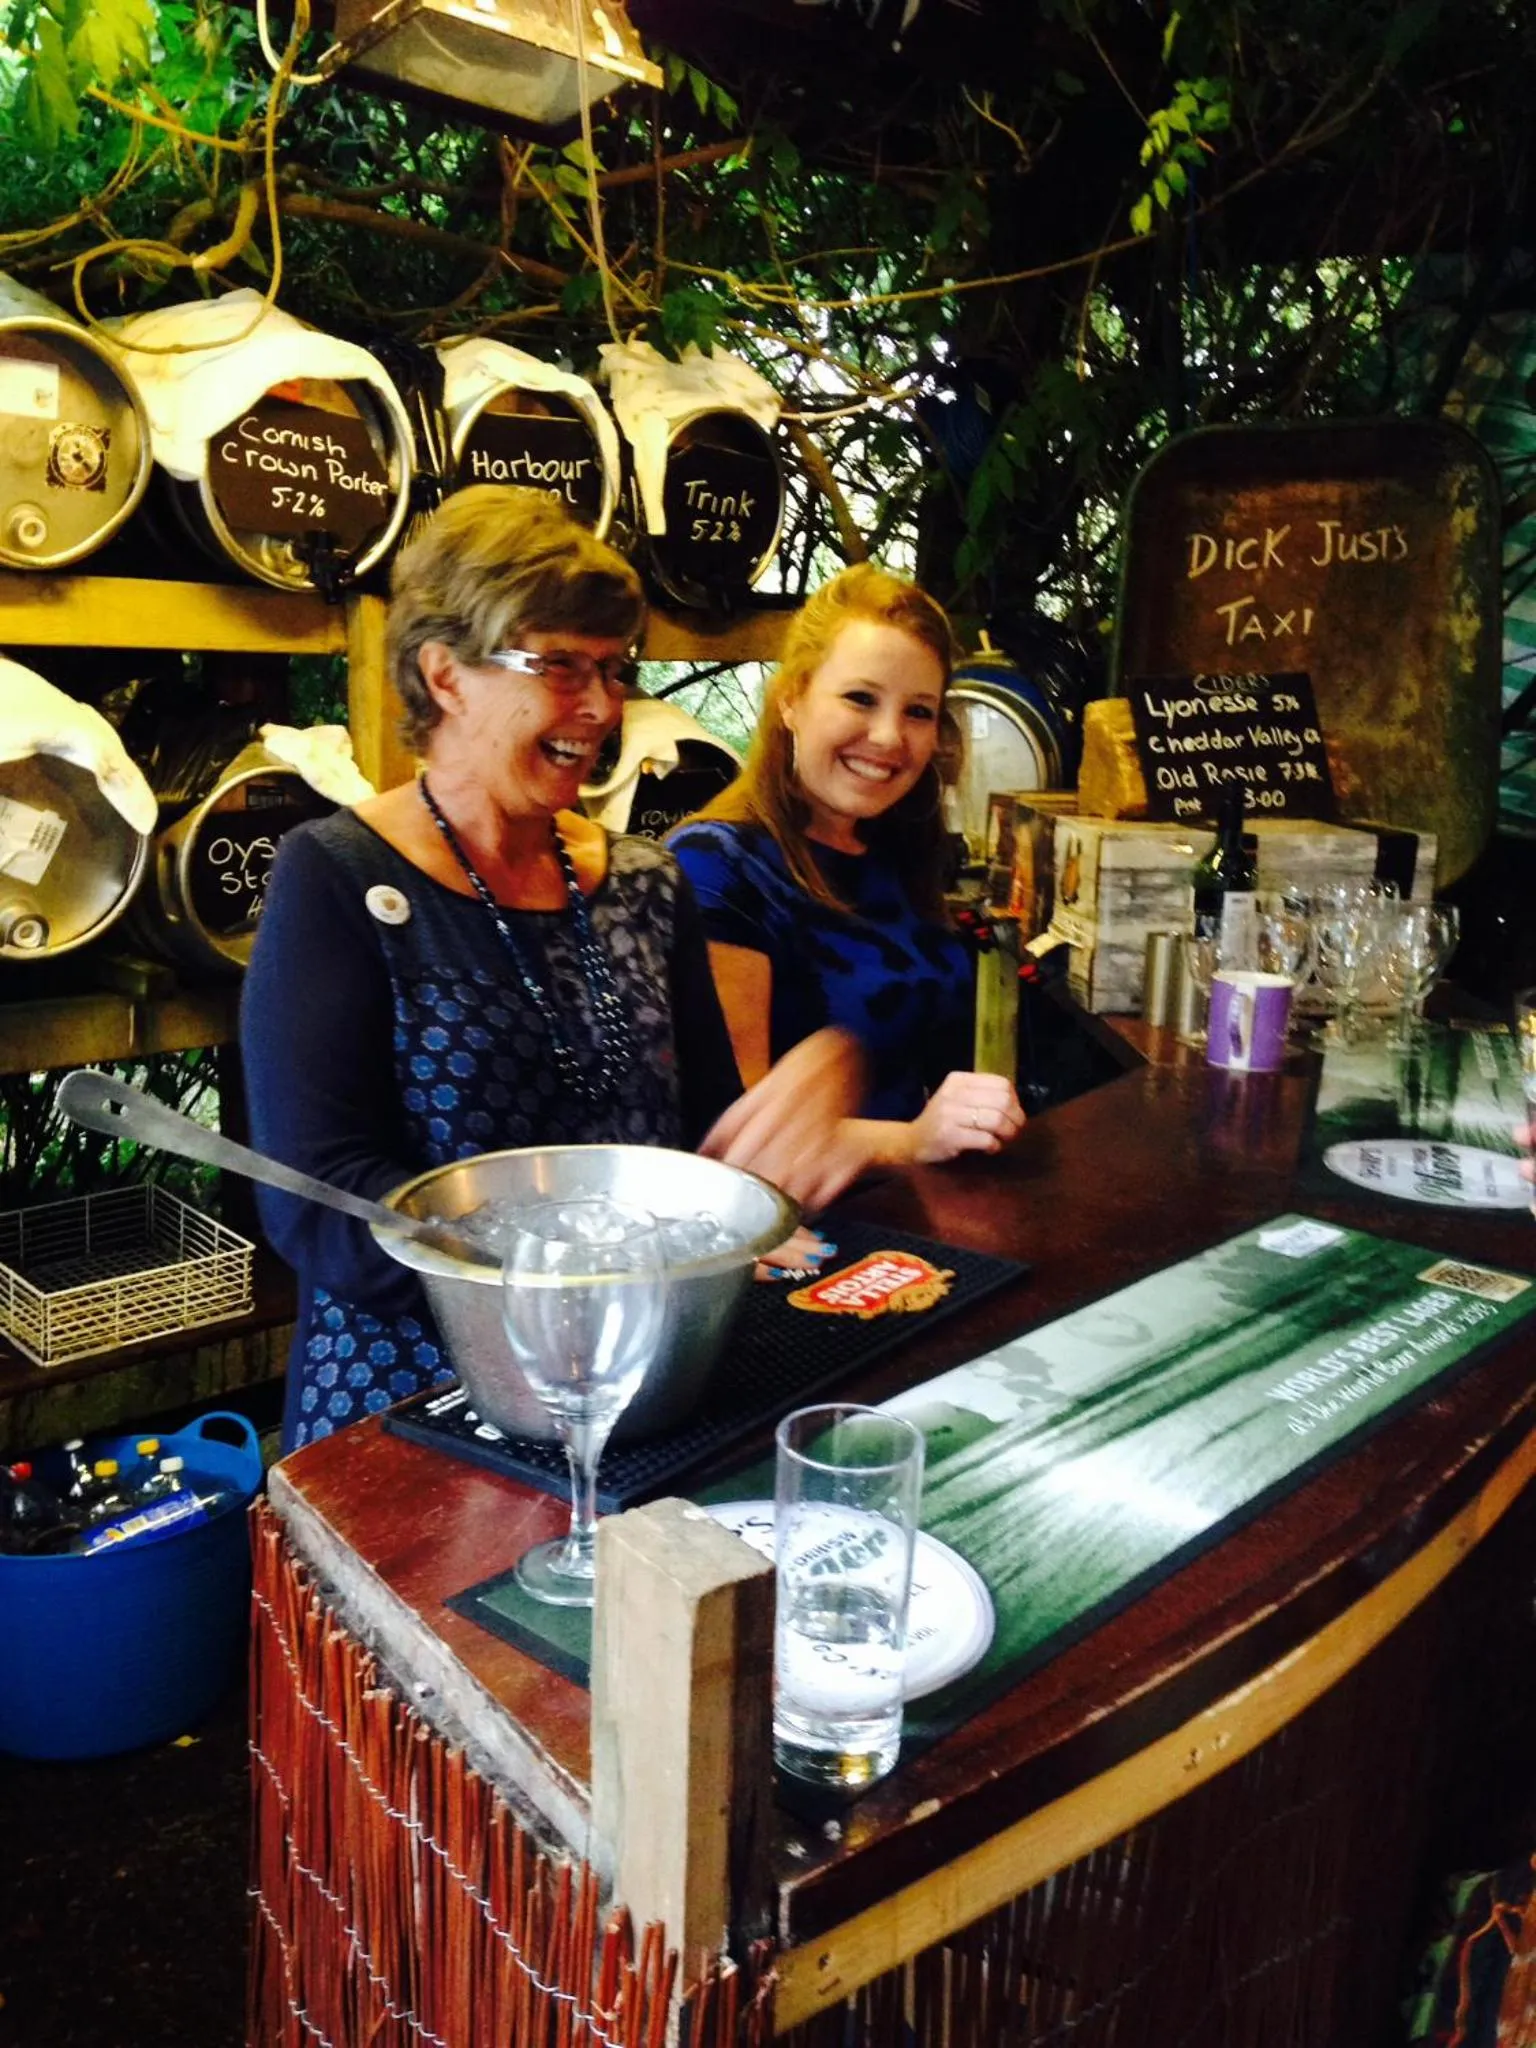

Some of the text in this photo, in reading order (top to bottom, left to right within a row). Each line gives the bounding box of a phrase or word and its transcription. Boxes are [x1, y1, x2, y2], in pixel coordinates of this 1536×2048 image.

[238, 416, 348, 460] Cornish
[221, 441, 389, 496] Crown Porter
[471, 450, 592, 483] Harbour
[271, 486, 326, 518] 5.2%
[683, 479, 756, 519] Trink
[1143, 691, 1260, 729] Lyonesse
[1247, 725, 1304, 757] Valley
[1156, 764, 1199, 790] Old
[208, 836, 278, 871] Oys
[1347, 1320, 1408, 1362] BEST
